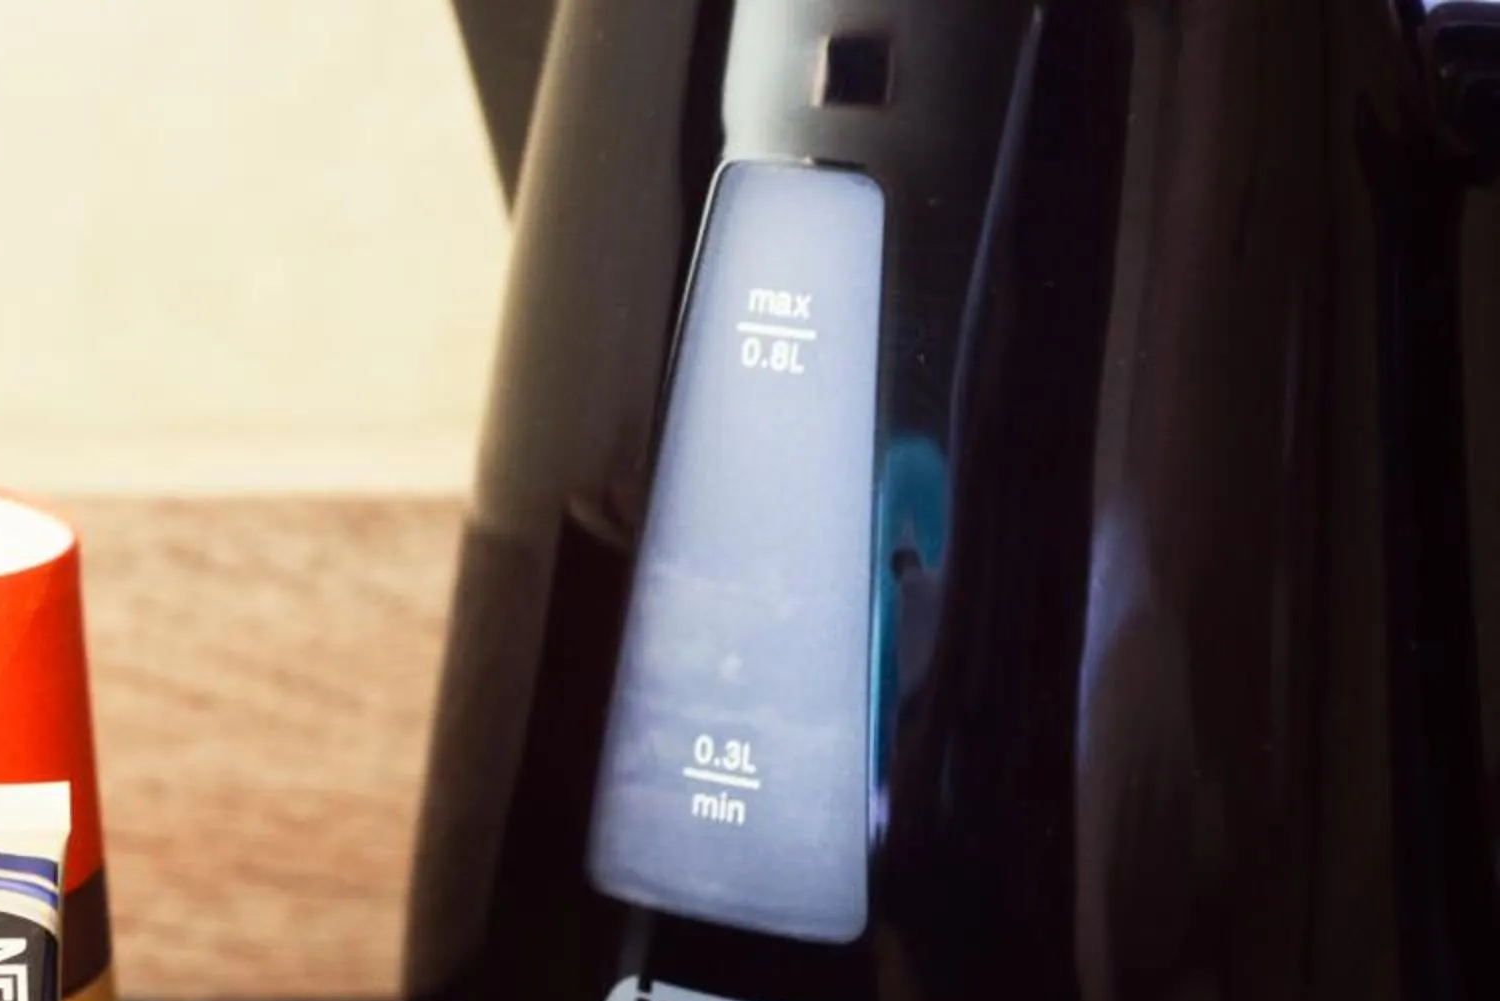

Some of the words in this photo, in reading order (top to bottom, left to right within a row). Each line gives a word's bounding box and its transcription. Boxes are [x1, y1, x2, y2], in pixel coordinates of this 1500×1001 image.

[748, 286, 812, 321] max
[693, 734, 758, 774] 0.3L
[691, 791, 746, 826] min
